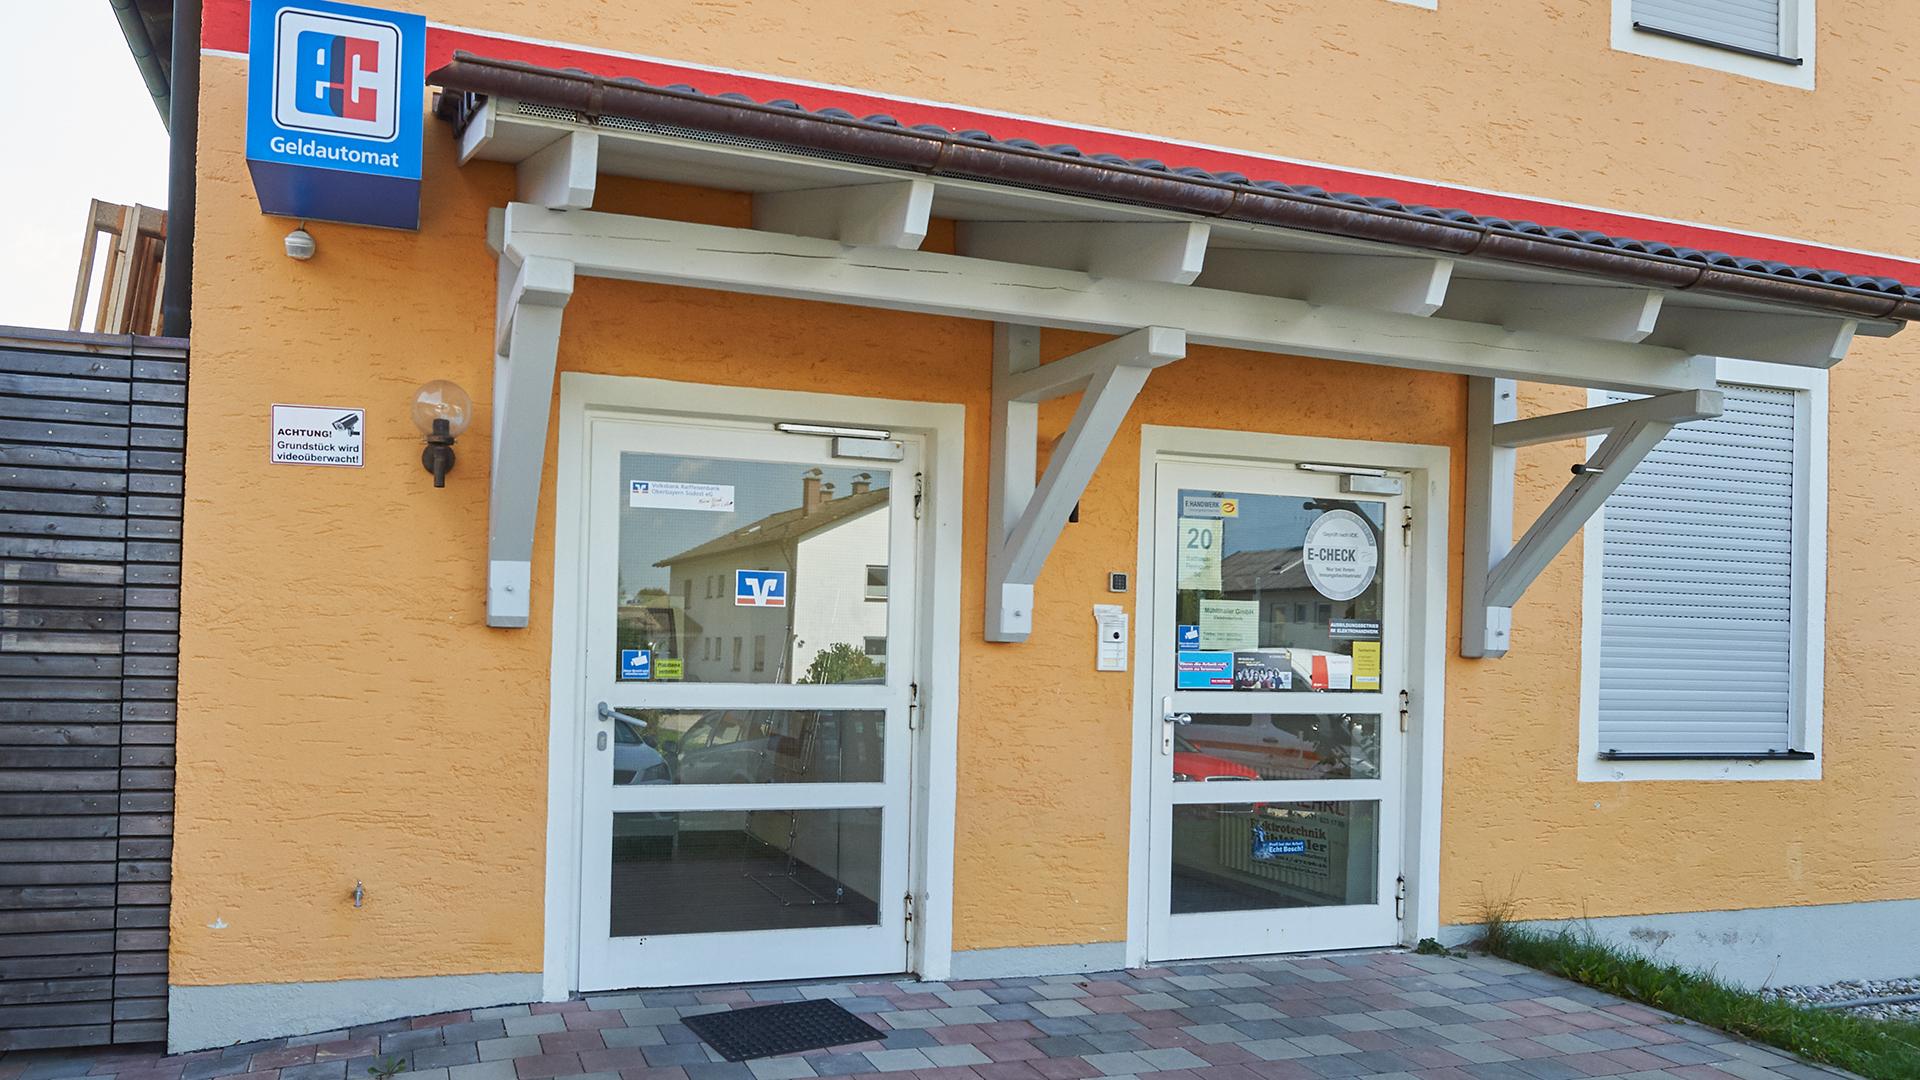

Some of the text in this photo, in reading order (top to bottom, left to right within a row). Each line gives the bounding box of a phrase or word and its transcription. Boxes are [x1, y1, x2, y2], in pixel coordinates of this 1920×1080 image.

[270, 136, 400, 168] Geldautomat
[277, 428, 332, 438] ACHTUNG!
[277, 441, 335, 452] Grundstück
[277, 452, 359, 463] videoüberwacht!
[1187, 527, 1213, 550] 20
[1307, 547, 1356, 562] E-CHECK
[1283, 845, 1304, 853] Bosch!
